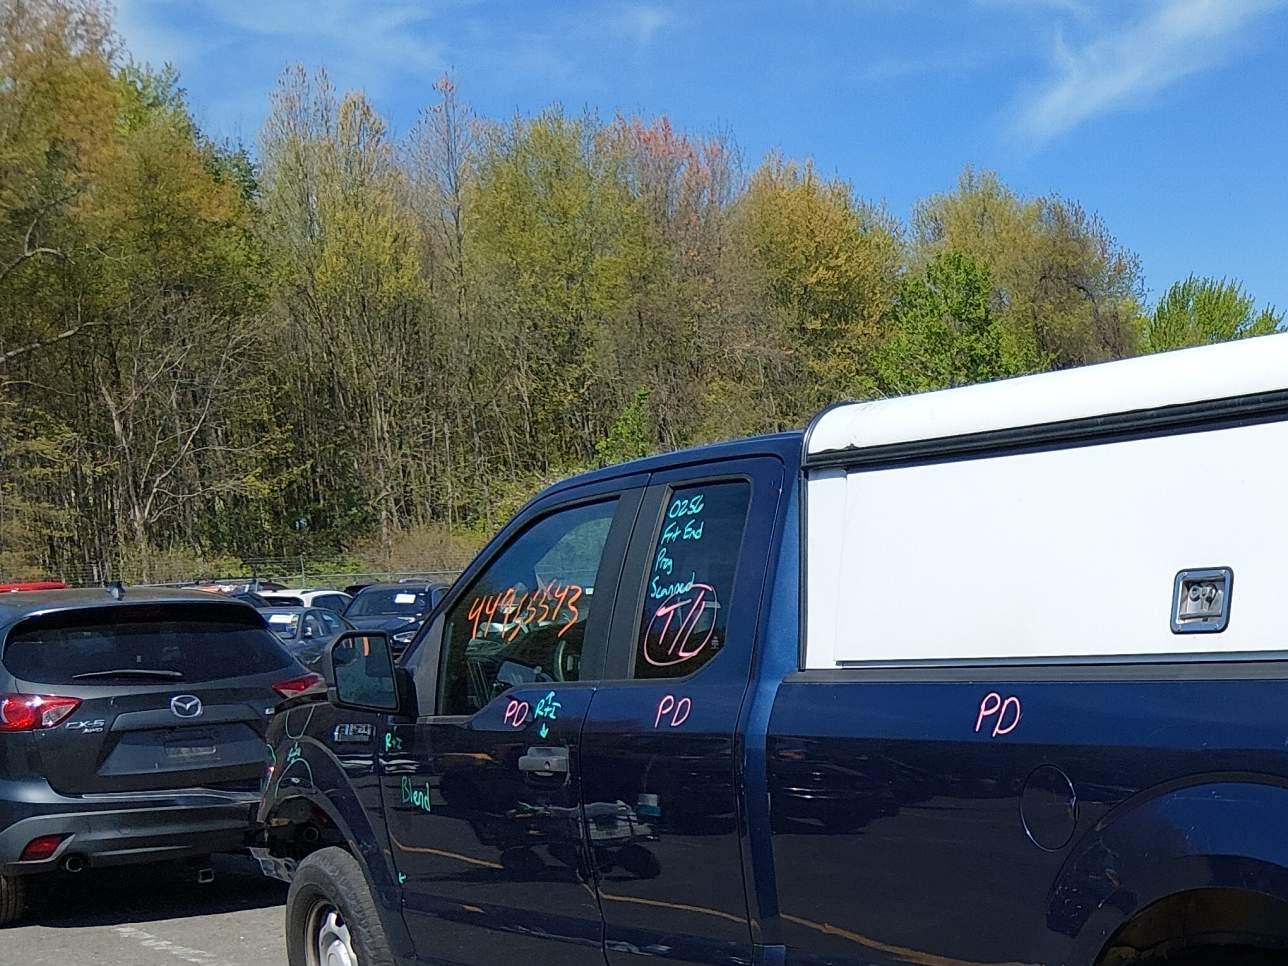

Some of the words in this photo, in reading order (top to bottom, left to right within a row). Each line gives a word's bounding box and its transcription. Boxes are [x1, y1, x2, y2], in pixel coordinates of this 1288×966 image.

[683, 519, 704, 540] End
[65, 719, 105, 730] CX-5
[504, 700, 529, 727] PD
[655, 695, 692, 728] PD
[976, 692, 1020, 737] PD
[401, 775, 432, 812] Blend
